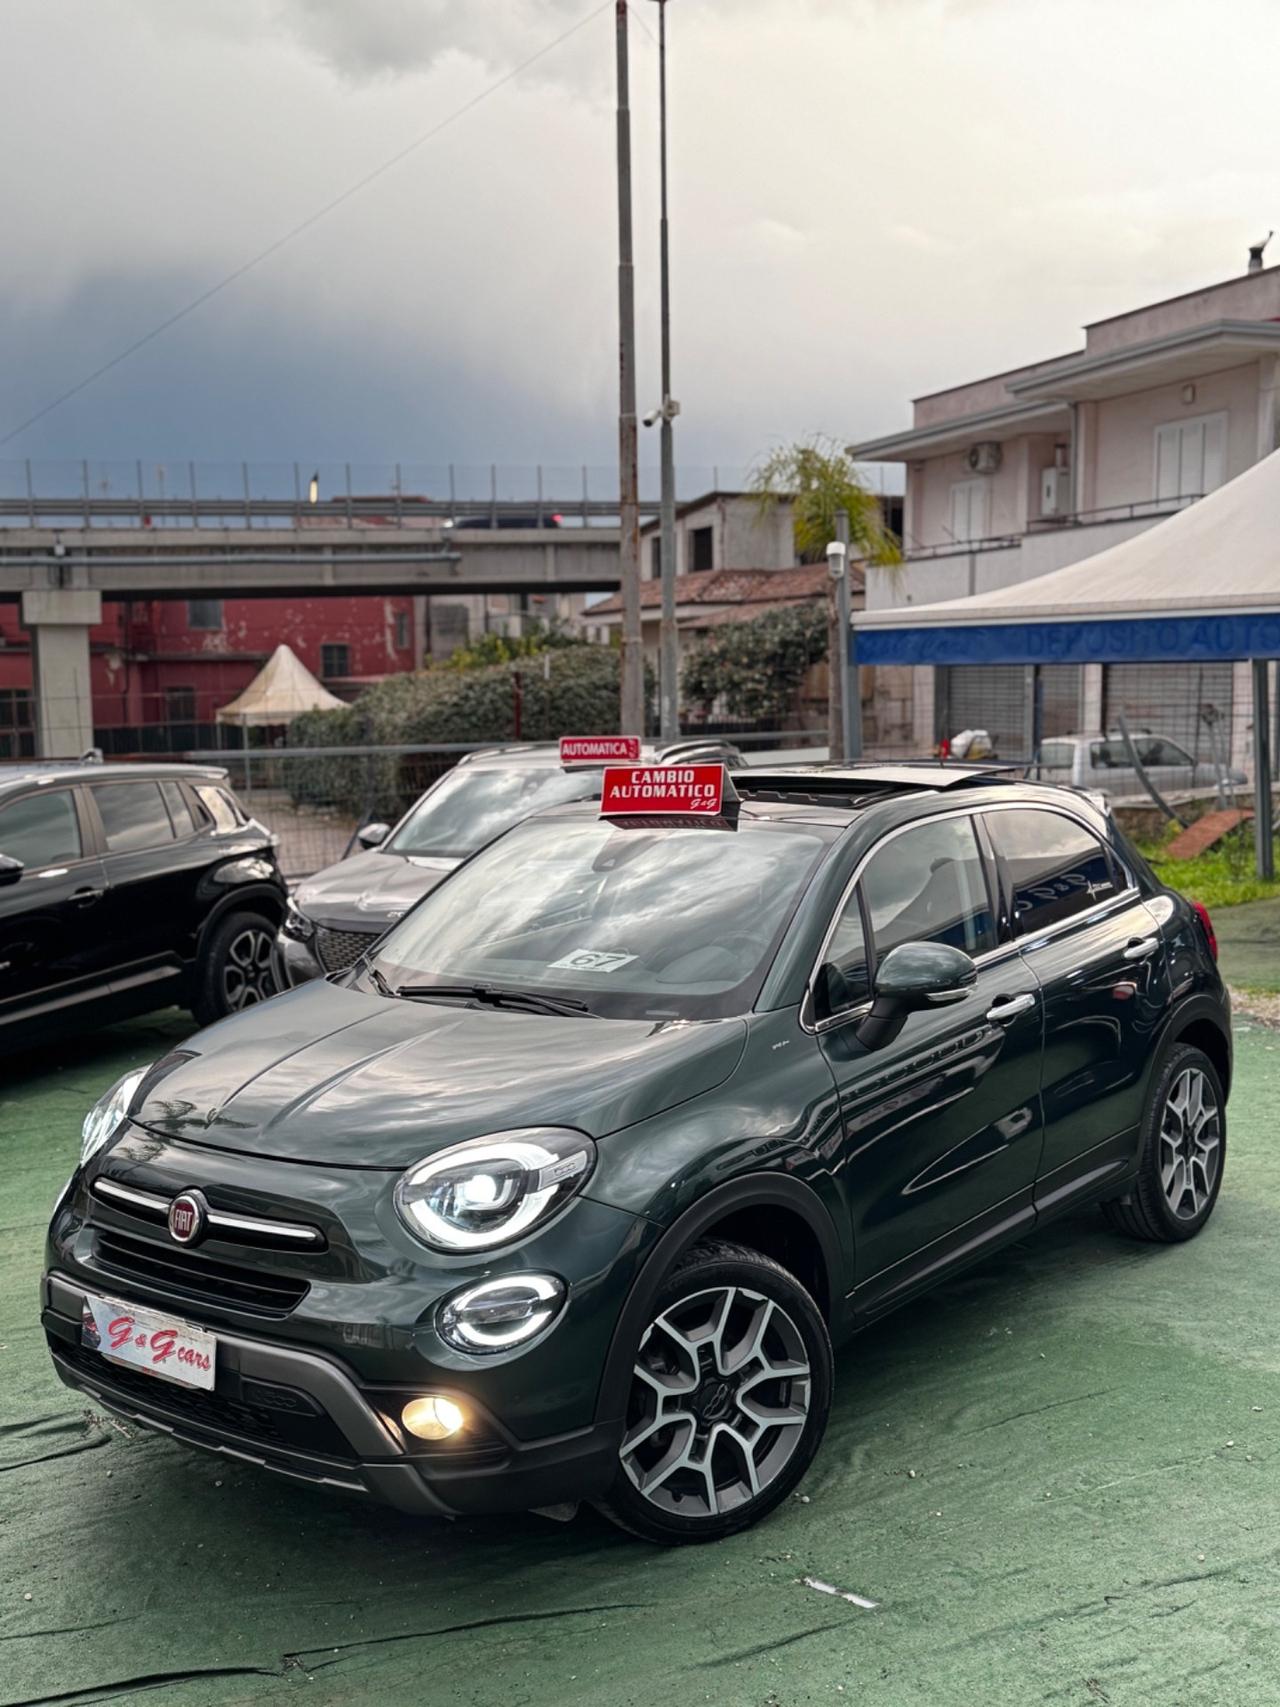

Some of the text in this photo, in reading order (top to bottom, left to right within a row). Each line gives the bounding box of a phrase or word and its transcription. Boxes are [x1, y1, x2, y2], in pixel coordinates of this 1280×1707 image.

[562, 742, 628, 756] AUTOMATICA
[631, 769, 694, 784] CAMBIO
[609, 784, 715, 799] AUTOMATICO
[570, 953, 627, 967] 67
[174, 1209, 193, 1232] FIAT
[176, 1346, 212, 1372] cars
